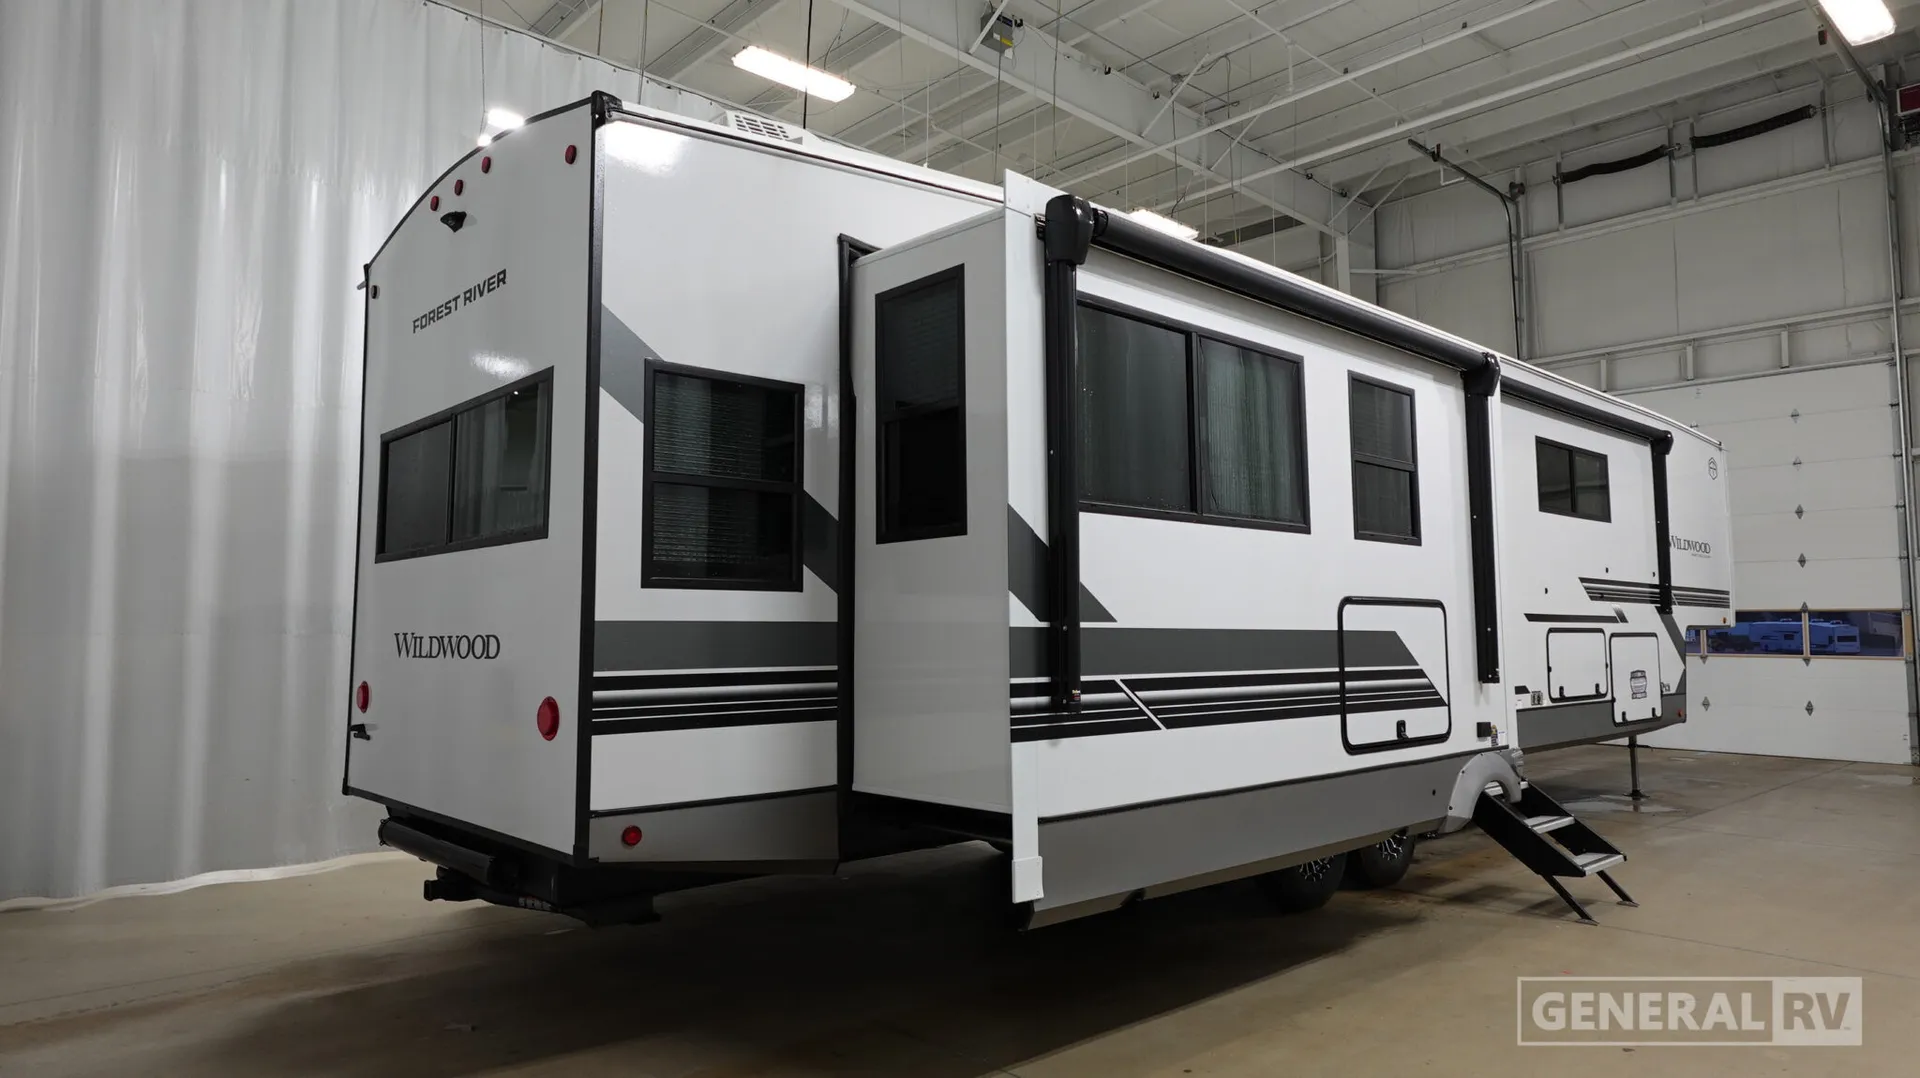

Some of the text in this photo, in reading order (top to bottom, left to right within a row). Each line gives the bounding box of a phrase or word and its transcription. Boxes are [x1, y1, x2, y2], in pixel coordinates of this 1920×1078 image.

[412, 268, 507, 334] FOREST RIVER
[394, 632, 501, 659] WILDWOOD
